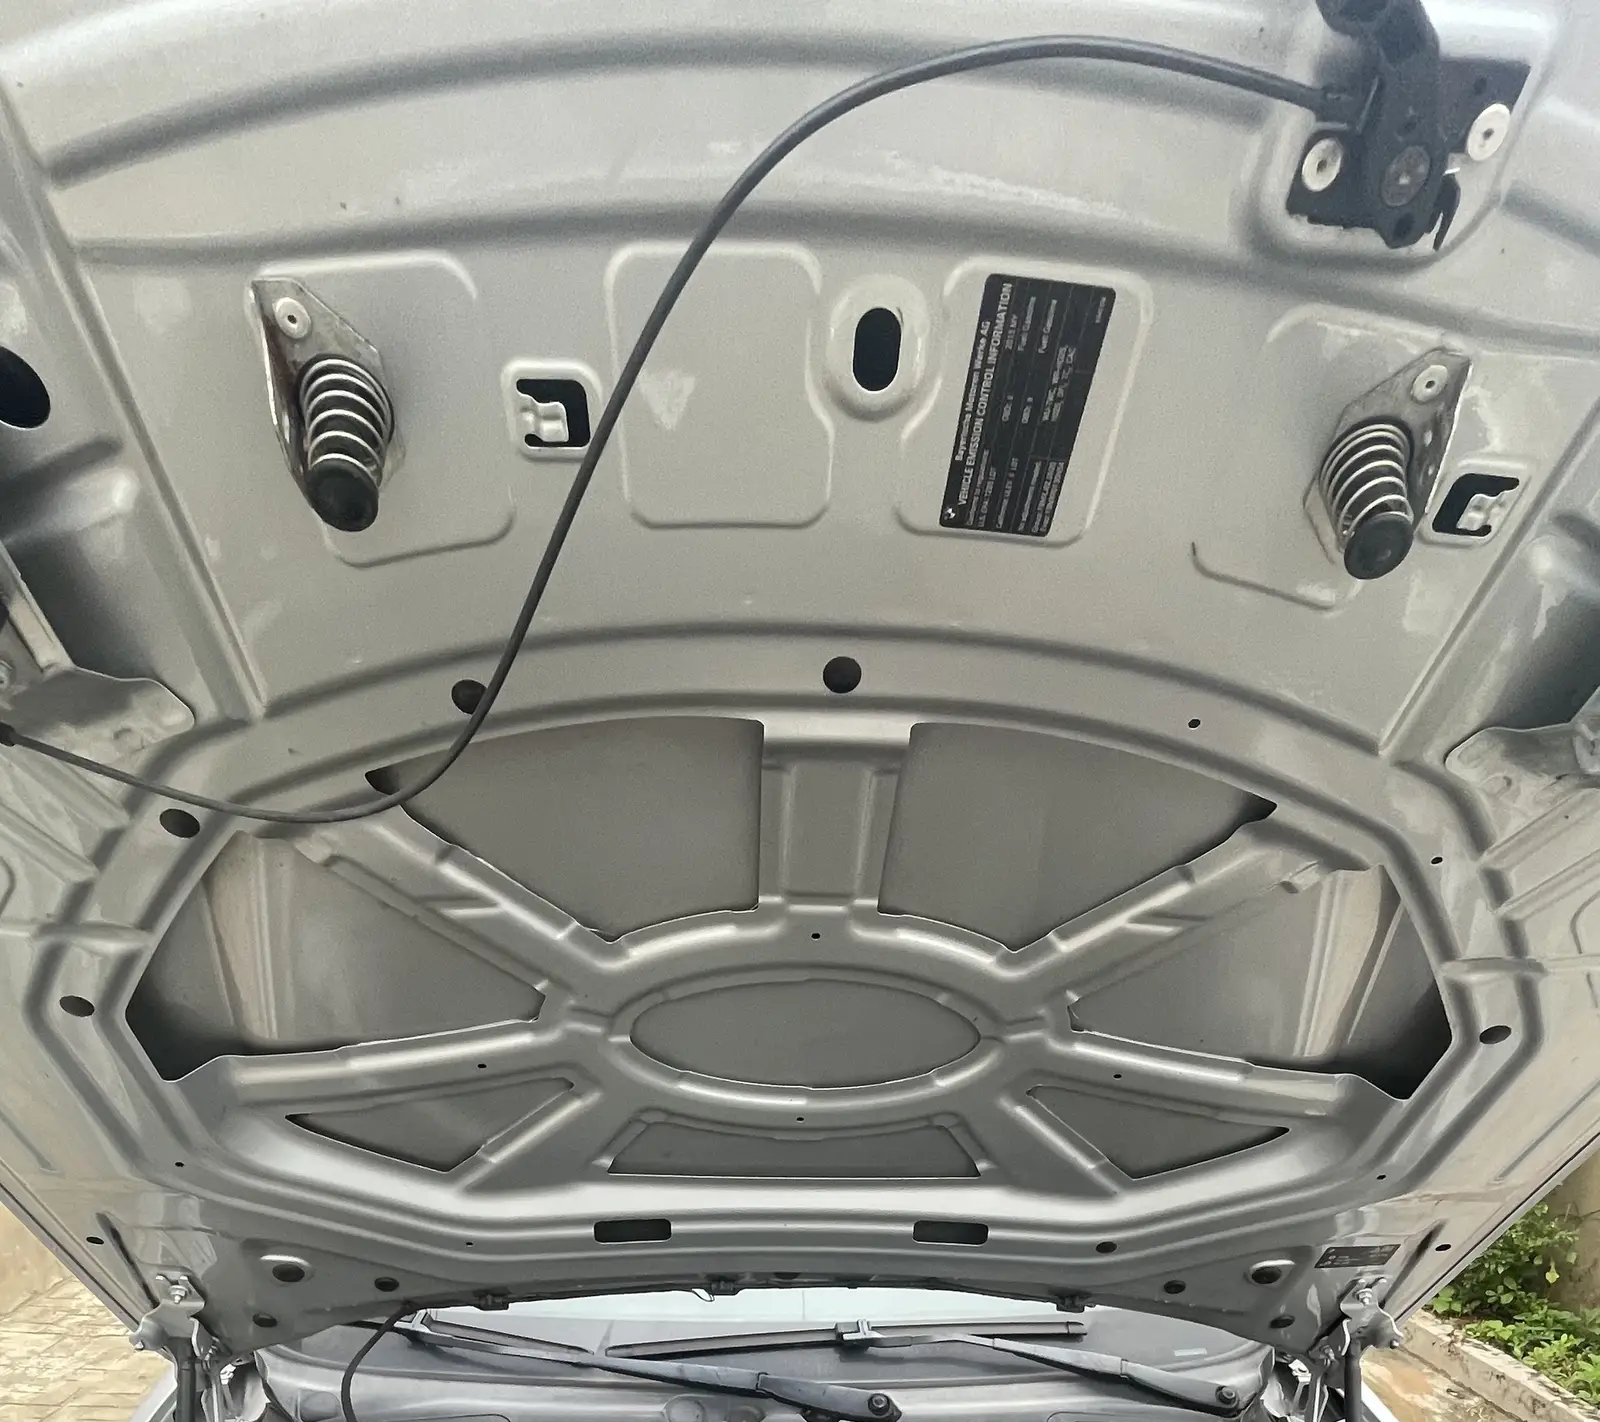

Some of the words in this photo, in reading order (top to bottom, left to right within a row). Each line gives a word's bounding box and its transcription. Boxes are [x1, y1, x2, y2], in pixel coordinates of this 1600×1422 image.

[987, 283, 1013, 365] INFORMATION
[964, 371, 980, 412] Motoren
[973, 337, 987, 369] Werke
[980, 321, 991, 337] AG
[976, 366, 995, 416] CONTROL
[965, 417, 984, 466] EMISSION
[957, 467, 974, 505] VEHICLE
